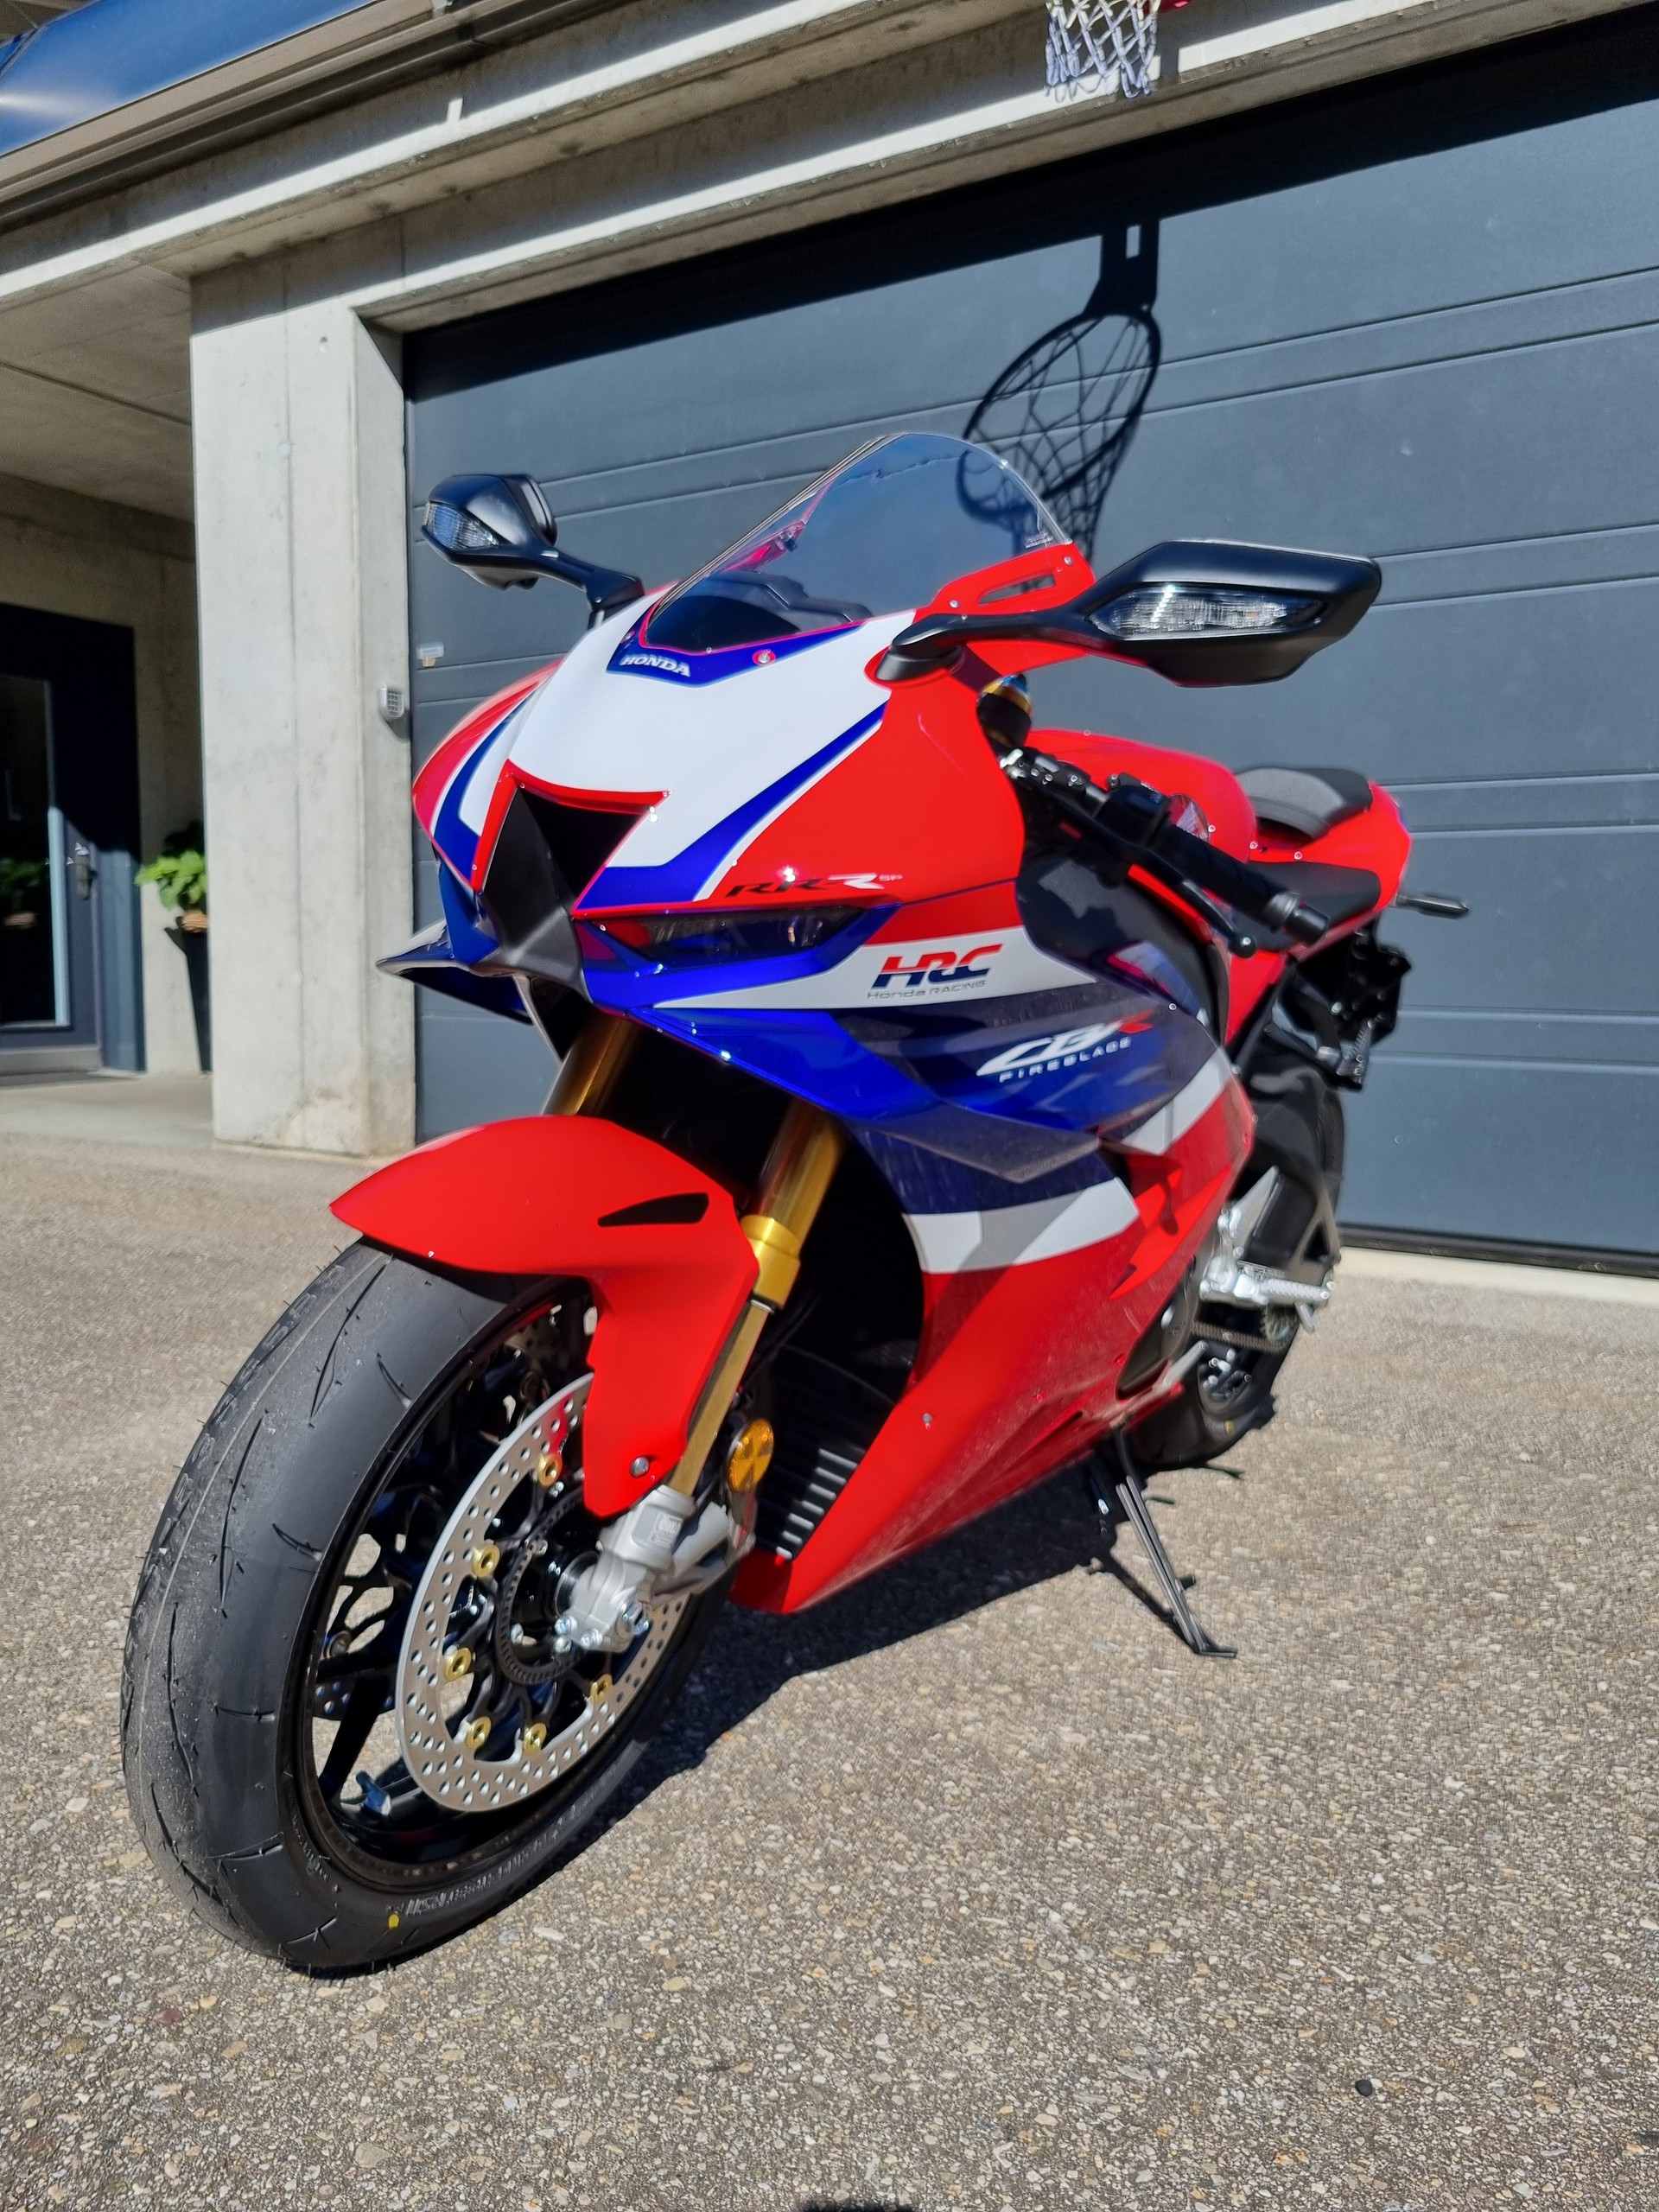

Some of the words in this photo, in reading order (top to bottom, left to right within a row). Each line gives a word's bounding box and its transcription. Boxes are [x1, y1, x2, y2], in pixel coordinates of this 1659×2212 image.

[620, 654, 690, 677] HONDA
[871, 944, 1004, 989] HRC
[867, 988, 925, 1000] Honda
[928, 979, 986, 996] RACING
[976, 1009, 1154, 1077] CBR
[999, 1036, 1132, 1083] FIREBLADE
